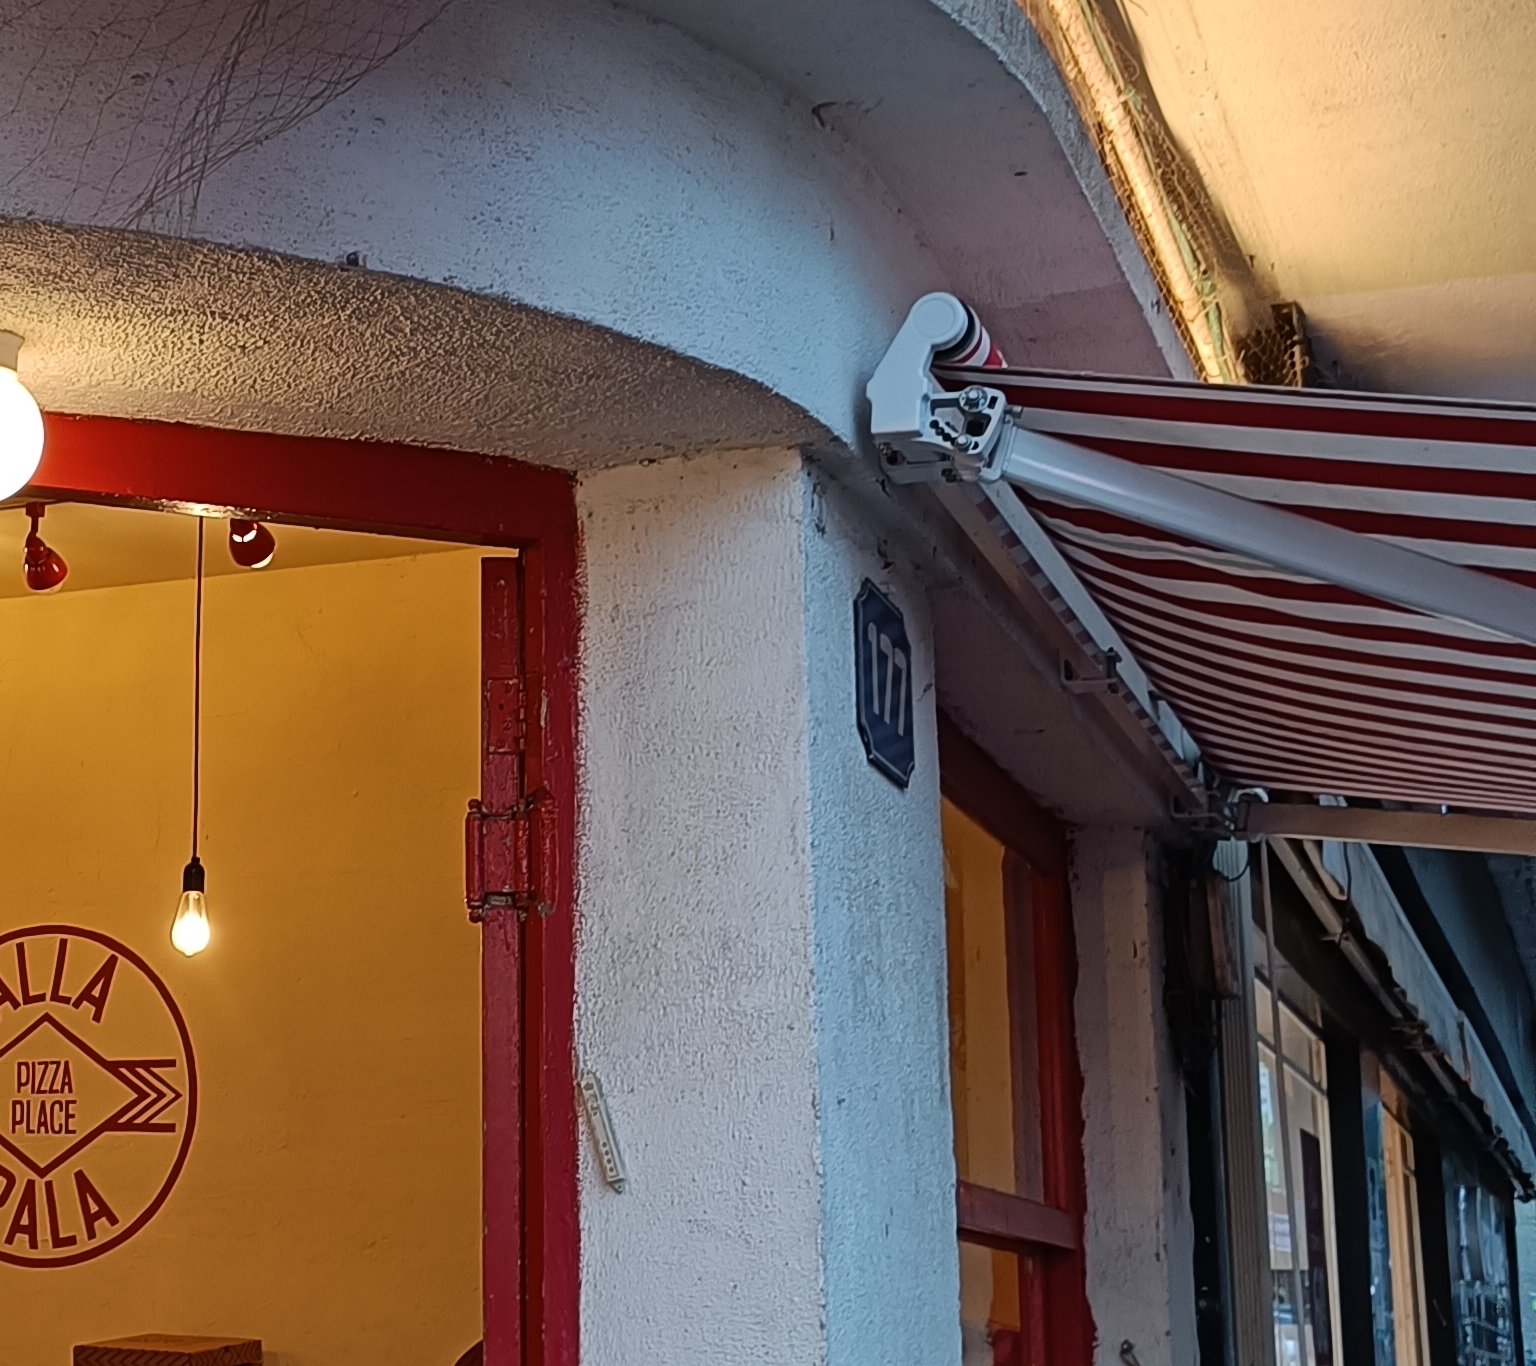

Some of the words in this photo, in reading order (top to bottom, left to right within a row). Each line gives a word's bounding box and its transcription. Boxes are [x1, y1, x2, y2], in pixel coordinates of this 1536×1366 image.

[866, 621, 907, 737] 177
[16, 1060, 74, 1095] PIZZA
[11, 1099, 78, 1135] PLACE
